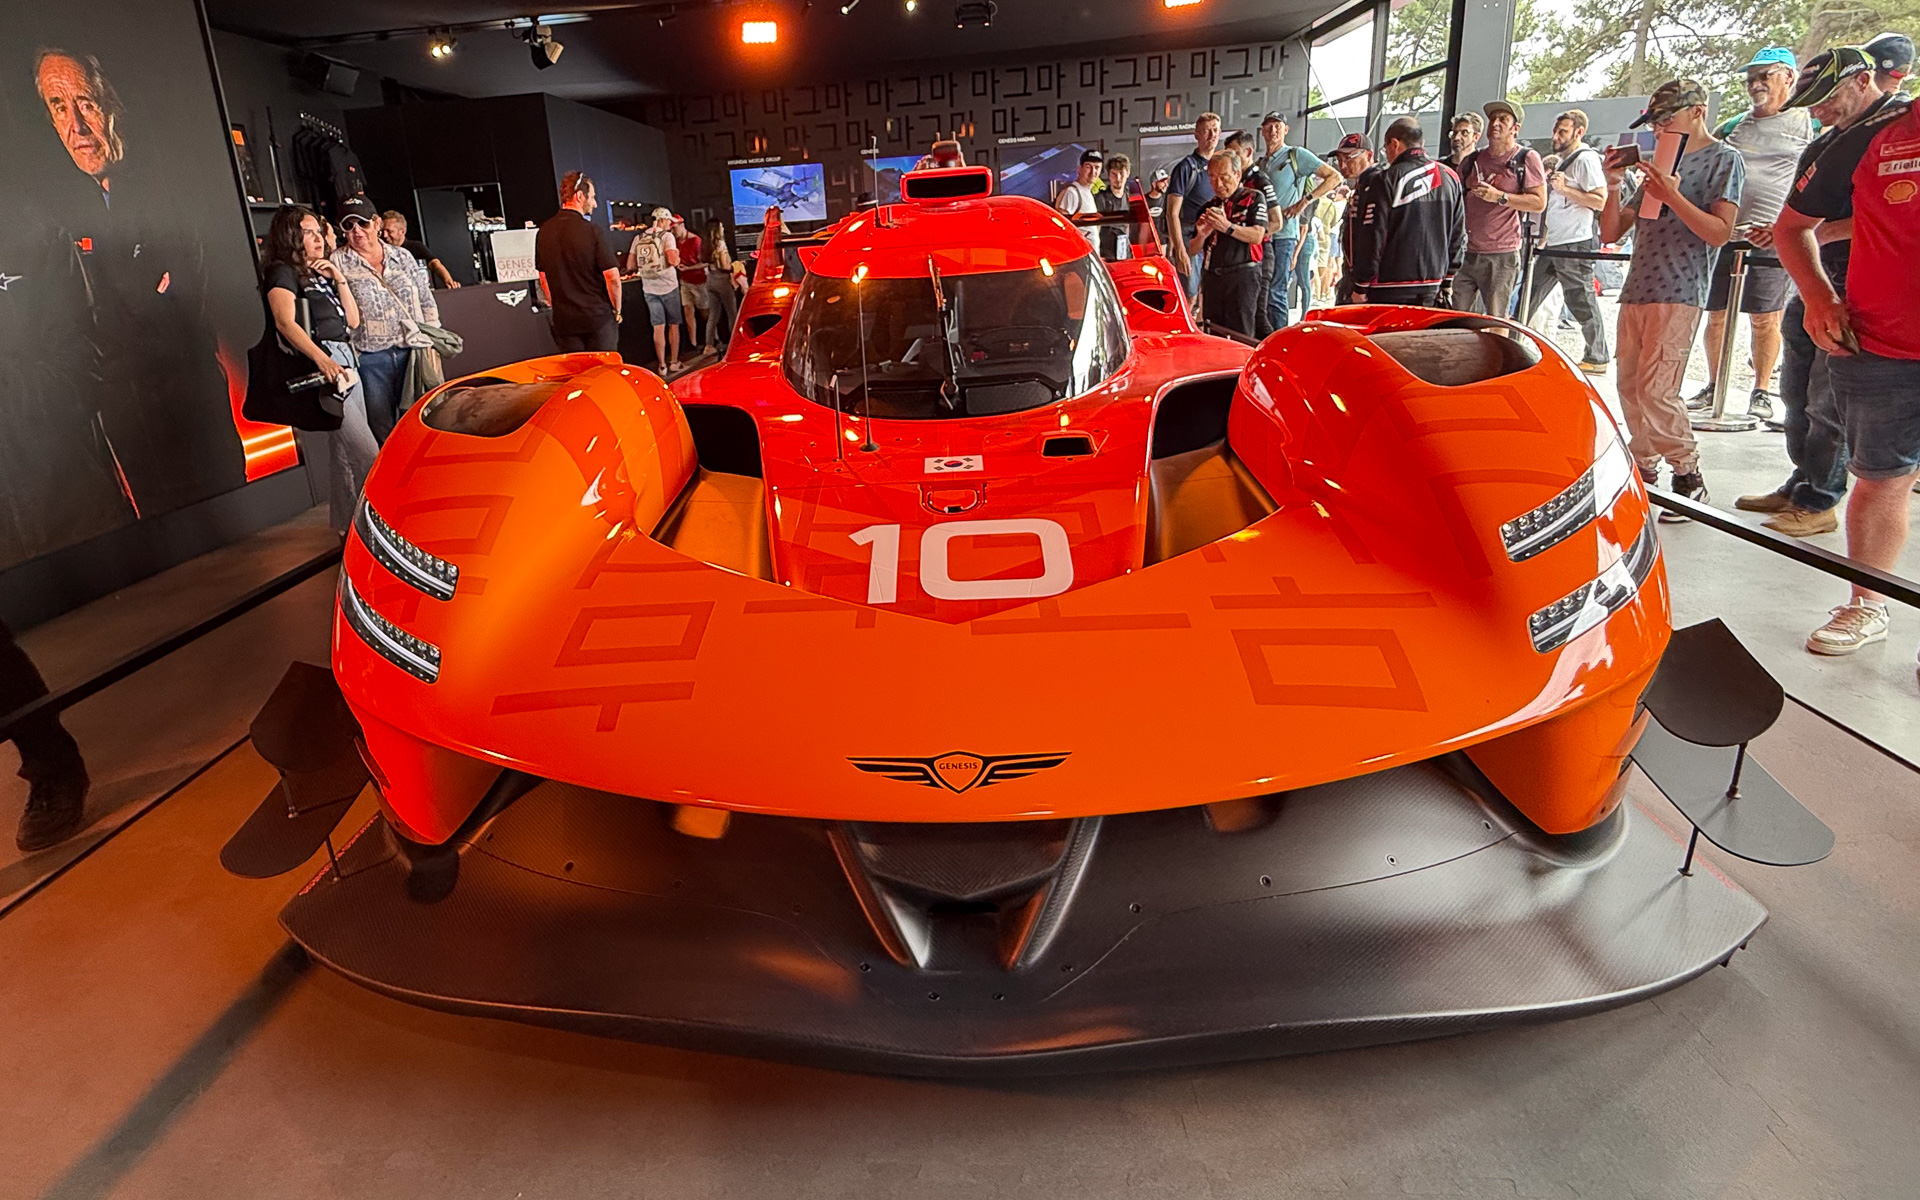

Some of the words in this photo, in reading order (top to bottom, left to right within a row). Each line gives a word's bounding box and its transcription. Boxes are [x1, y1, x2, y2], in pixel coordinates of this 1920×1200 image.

[1893, 159, 1920, 171] riell
[497, 259, 533, 269] GENES
[499, 270, 537, 278] MAGM
[848, 518, 1074, 604] 10
[939, 761, 978, 770] GENESIS
